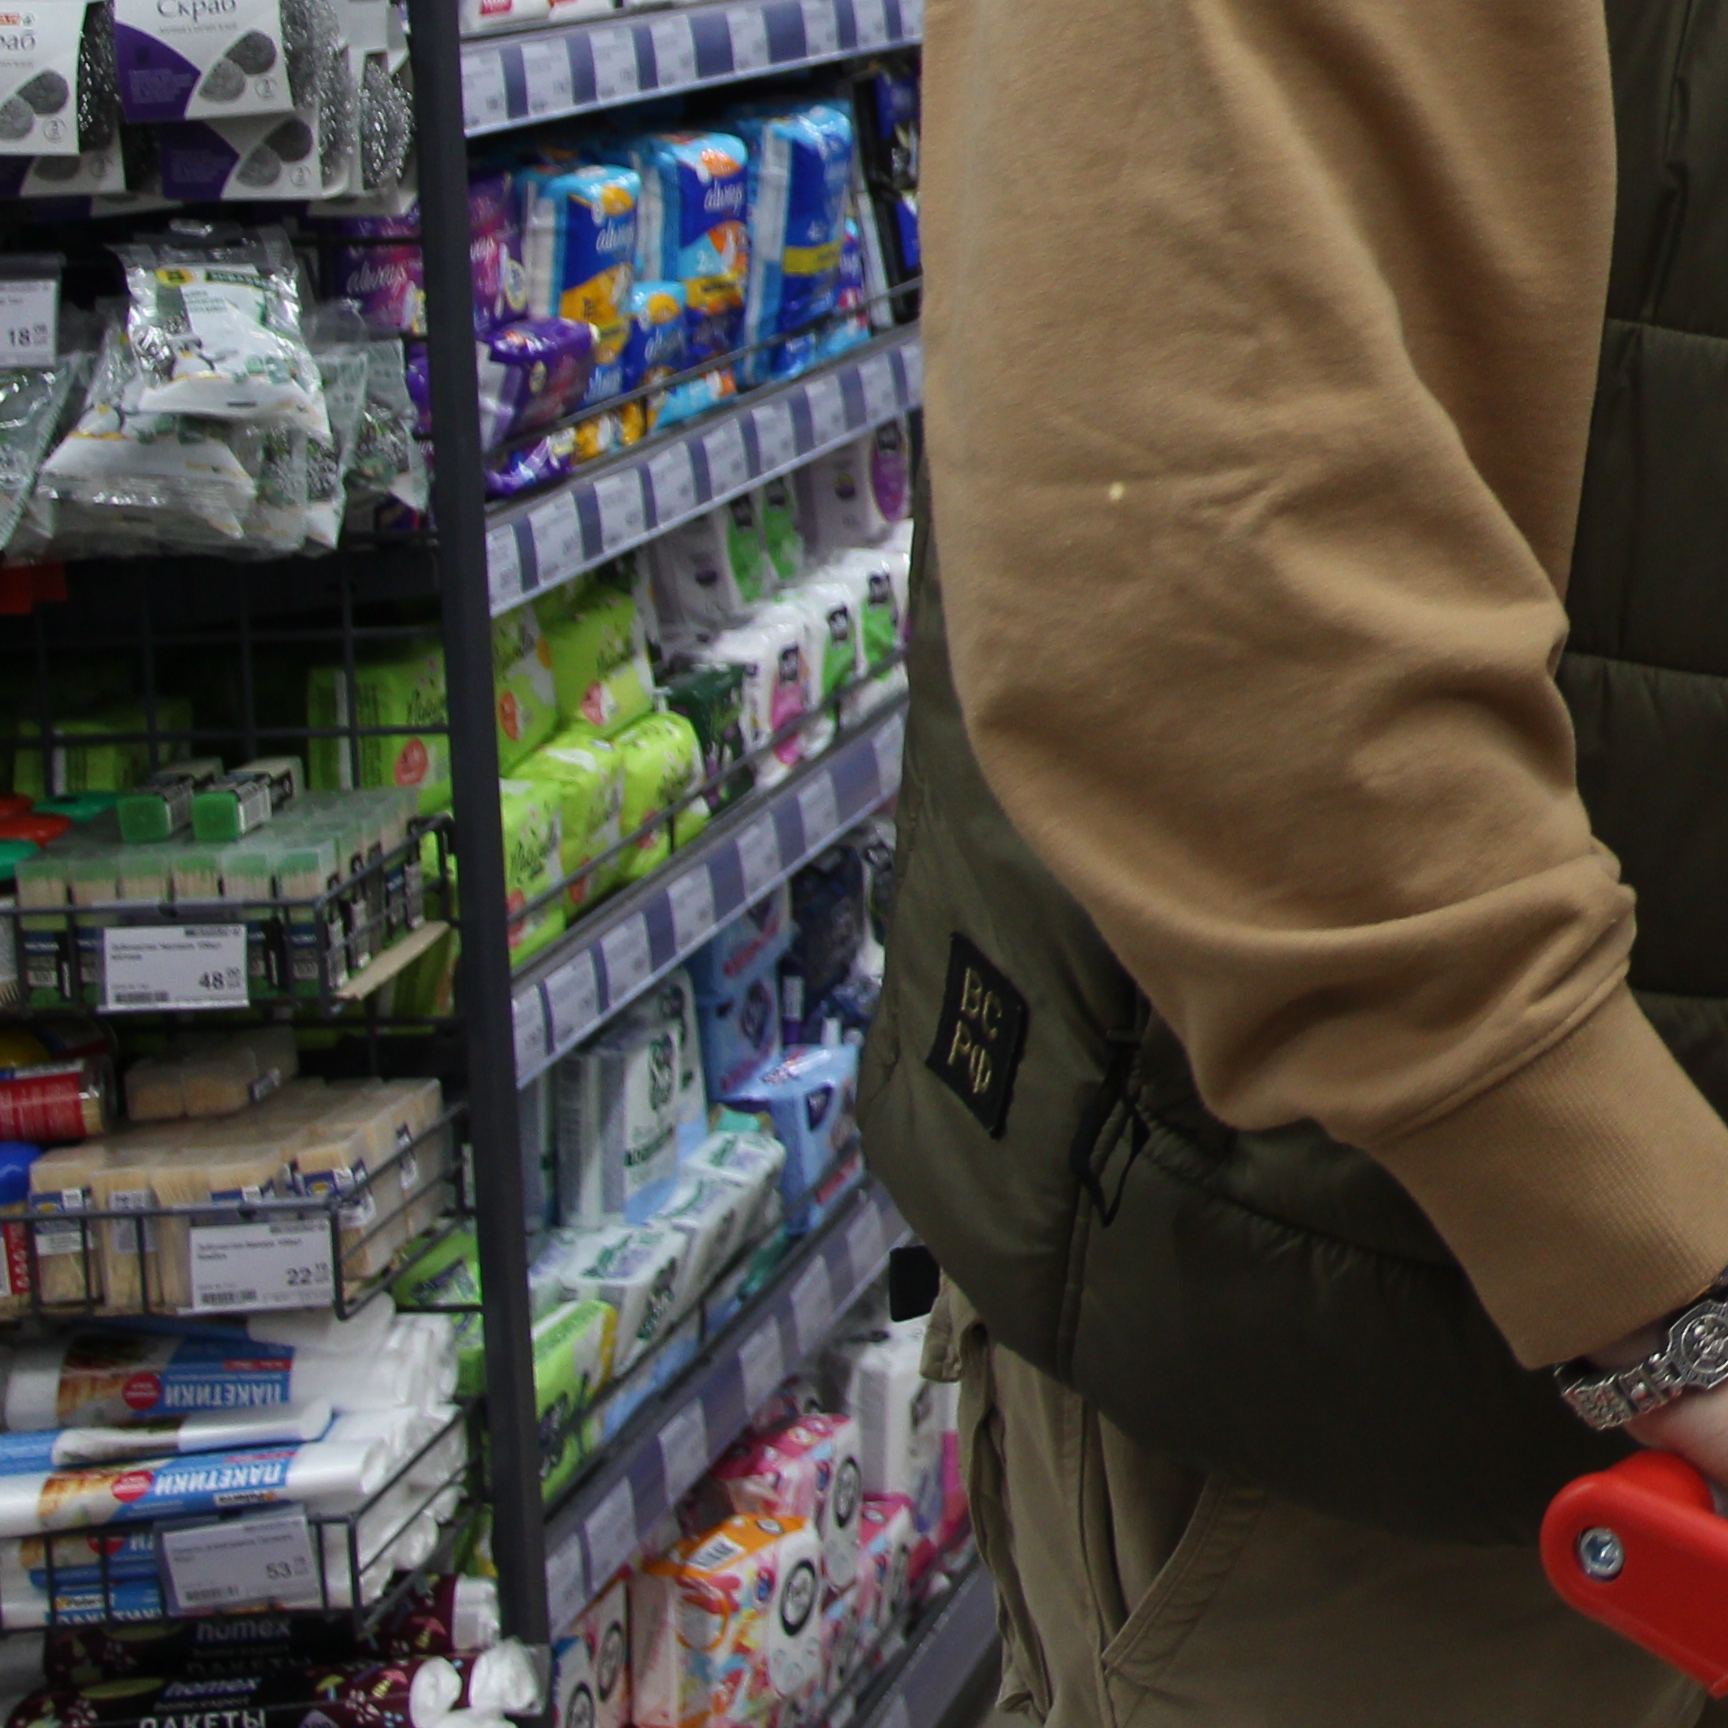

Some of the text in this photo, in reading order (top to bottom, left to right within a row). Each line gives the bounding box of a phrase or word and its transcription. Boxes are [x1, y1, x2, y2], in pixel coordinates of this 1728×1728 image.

[8, 328, 31, 348] 18
[200, 971, 225, 990] 48
[287, 1267, 313, 1286] 22
[164, 1382, 283, 1409] ПАКЕТИКИ
[153, 1462, 283, 1497] ПАКЕТИКИ
[265, 1560, 292, 1581] 53
[164, 1676, 261, 1698] homex
[138, 1708, 267, 1728] ПАКЕТЫ
